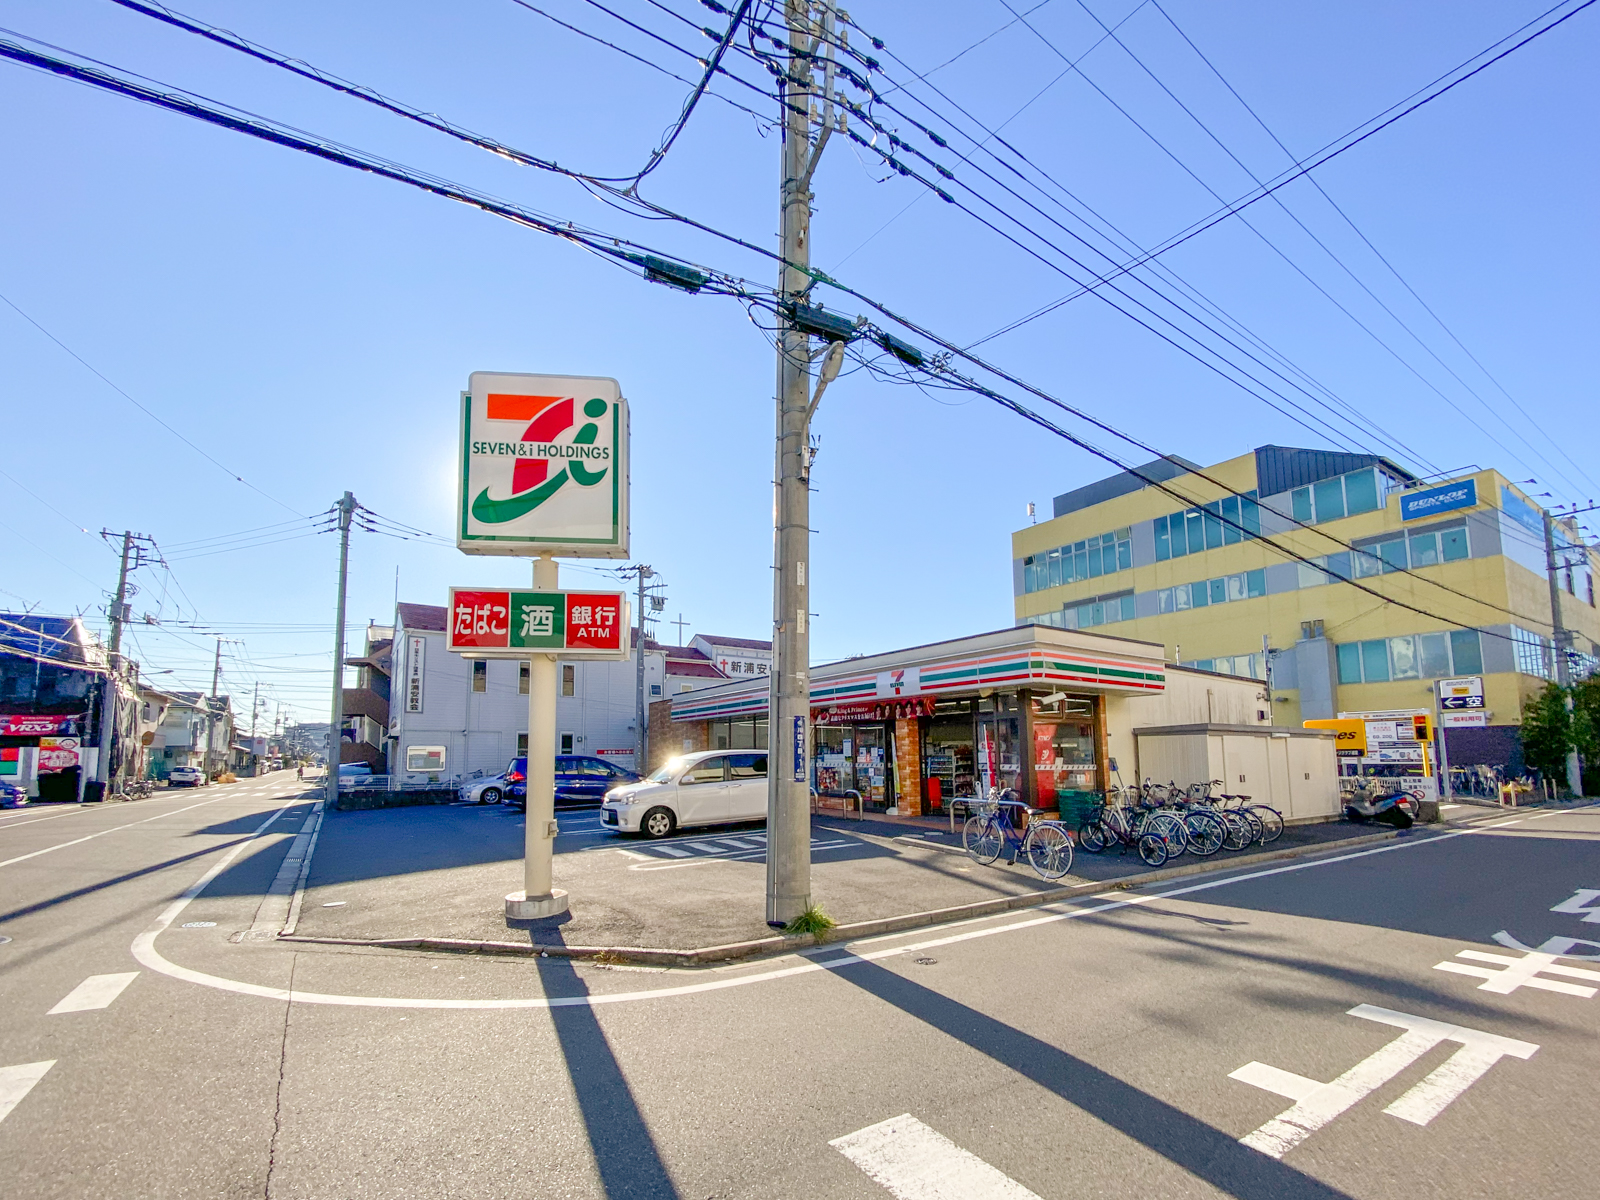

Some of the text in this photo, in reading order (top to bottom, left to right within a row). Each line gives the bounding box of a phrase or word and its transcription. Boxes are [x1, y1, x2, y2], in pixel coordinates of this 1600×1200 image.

[537, 444, 610, 460] HOLDINGS
[1407, 488, 1468, 509] DUNLOP
[454, 603, 508, 636] たばこ
[520, 604, 556, 637] 酒
[571, 605, 616, 626] 銀行
[577, 627, 610, 638] ATM
[730, 661, 772, 675] 新浦安
[1466, 696, 1483, 707] 空
[1333, 731, 1357, 740] es
